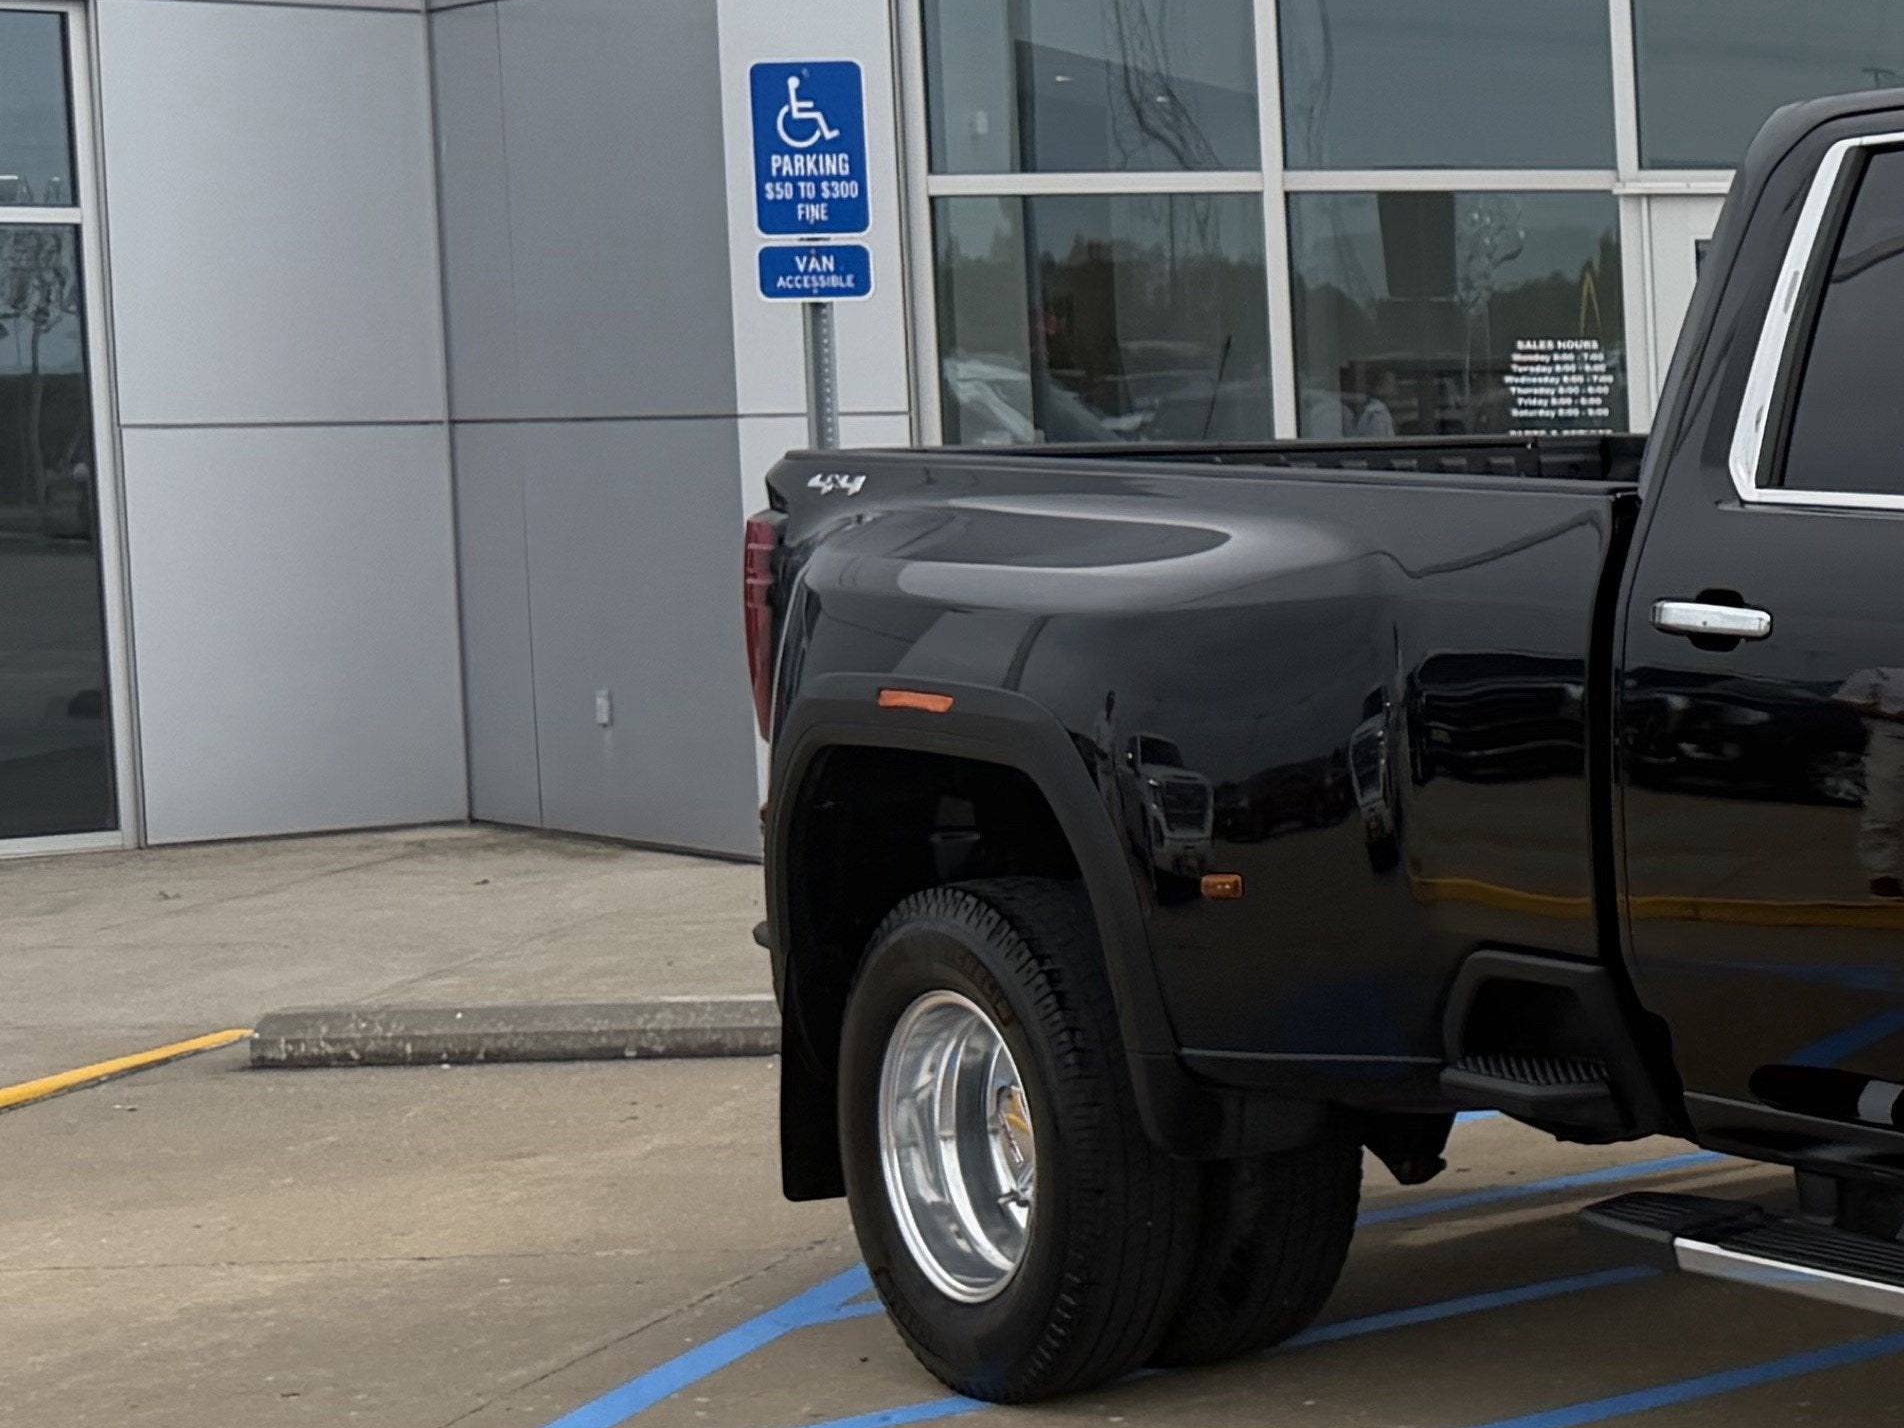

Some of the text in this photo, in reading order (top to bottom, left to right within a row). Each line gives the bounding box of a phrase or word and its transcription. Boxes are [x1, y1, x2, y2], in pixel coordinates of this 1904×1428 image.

[771, 153, 850, 177] PARKING
[764, 180, 859, 201] $50 TO $300
[797, 202, 829, 221] FINE
[795, 255, 835, 272] VAN
[776, 274, 855, 289] ACCESSIBLE
[1516, 339, 1599, 350] SALES HOURS
